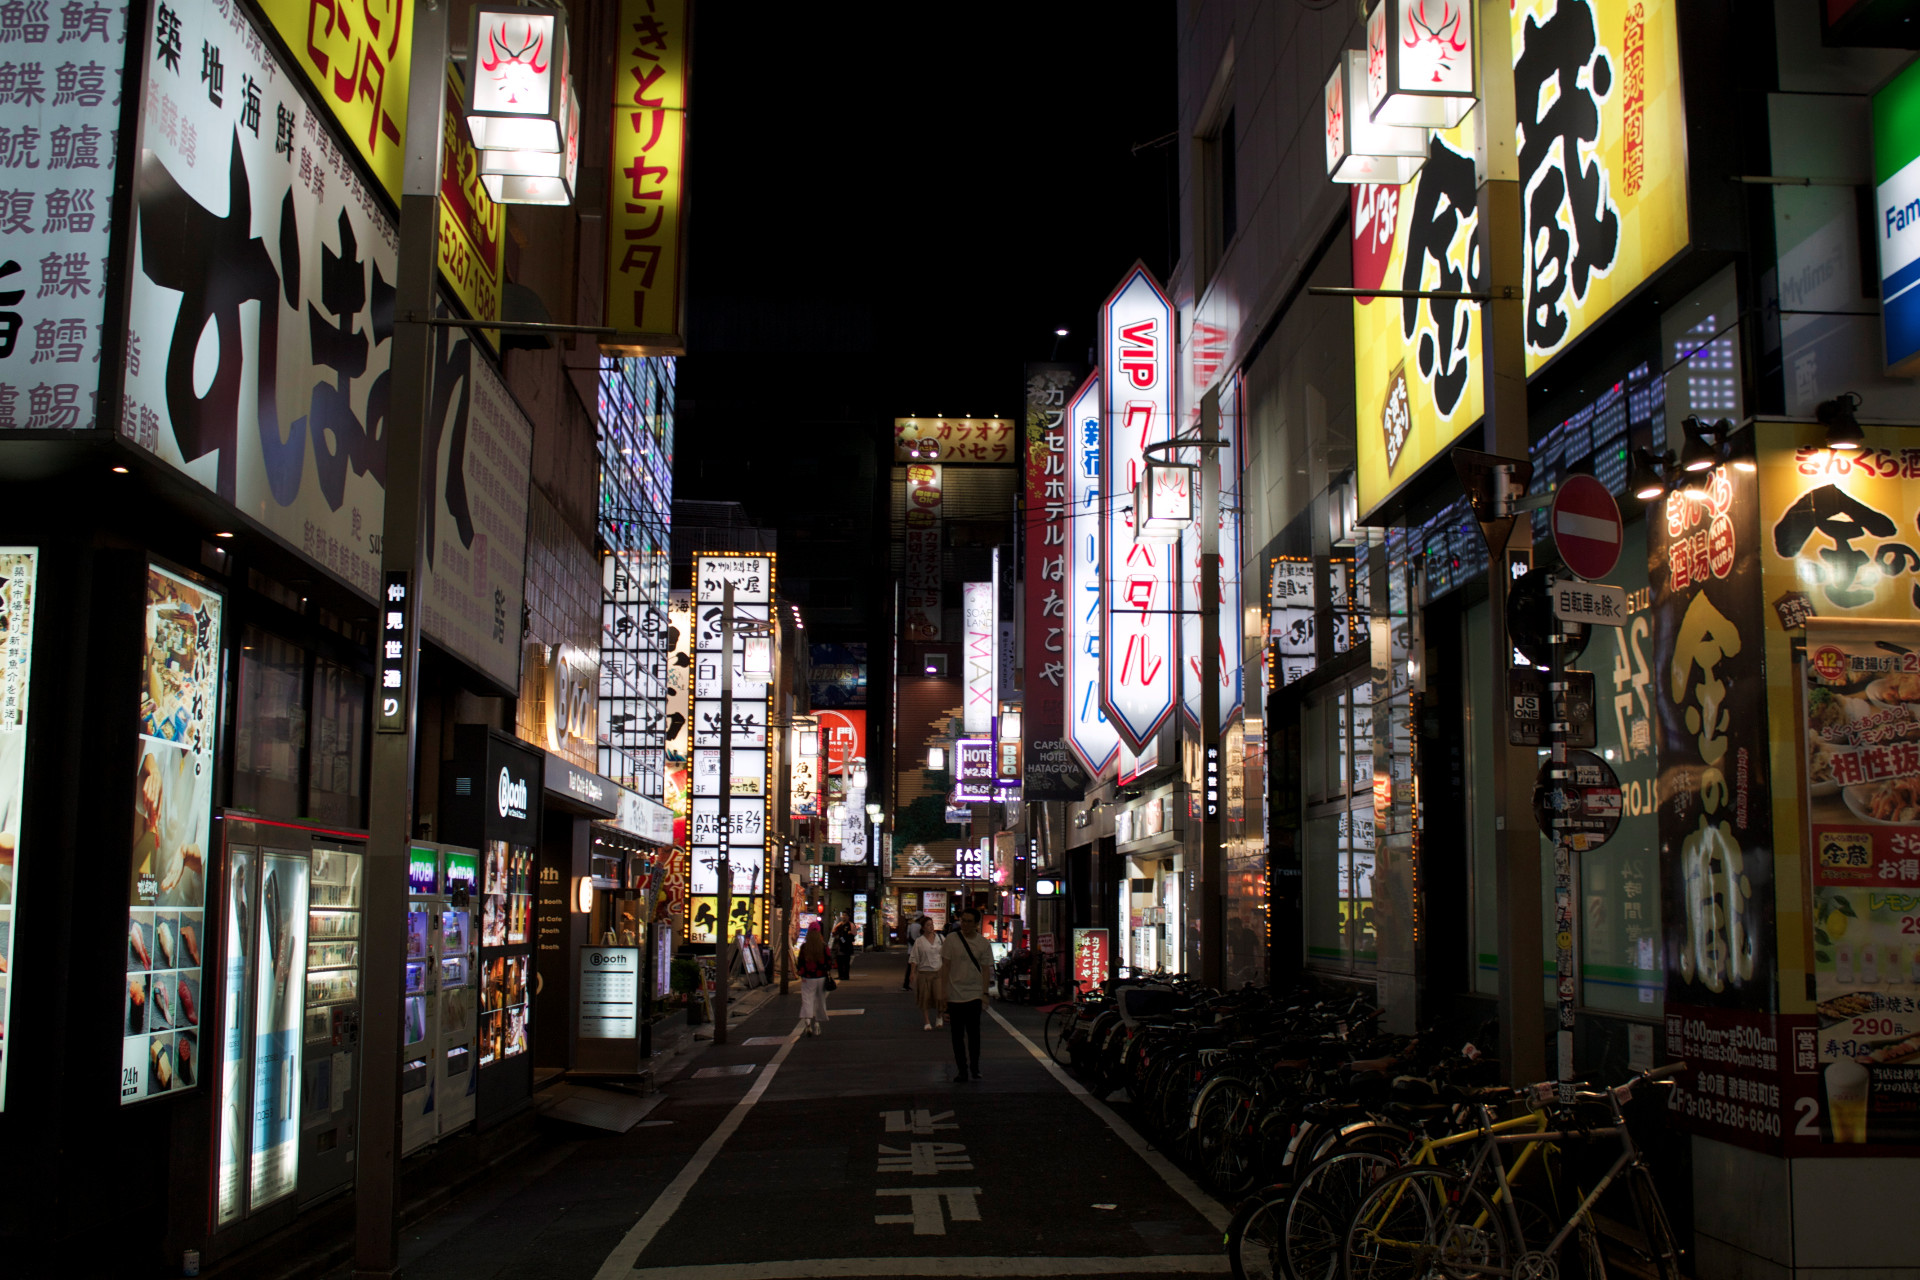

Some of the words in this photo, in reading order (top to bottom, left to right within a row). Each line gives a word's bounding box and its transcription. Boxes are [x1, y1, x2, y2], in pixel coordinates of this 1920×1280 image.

[156, 4, 297, 164] 築地海鮮
[1622, 1, 1645, 198] 登録商標
[619, 0, 669, 329] きとりセンター
[1119, 318, 1159, 391] VIP
[936, 421, 1014, 441] カラオケ
[945, 443, 1008, 461] パセラ
[1711, 519, 1727, 540] KIN
[1715, 537, 1727, 551] no
[1669, 529, 1709, 592] 酒場
[1711, 548, 1734, 570] KURA
[700, 592, 711, 600] 7F
[1560, 590, 1622, 619] 自転車を除く
[966, 619, 992, 629] LAND
[383, 583, 406, 717] 仲見世通り
[699, 641, 709, 649] 6F
[968, 631, 993, 706] MAX
[1851, 656, 1892, 672] 唐揚げ
[698, 689, 708, 697] 5F
[1517, 698, 1537, 709] JS
[1515, 709, 1539, 719] ONE
[1002, 745, 1018, 776] BBQ
[1040, 752, 1069, 762] HOTEL
[1028, 764, 1080, 774] HATAGOYA
[498, 766, 528, 818] Booth
[695, 824, 744, 834] PAROR
[696, 814, 744, 824] ATHEE
[1823, 842, 1868, 867] 金の蔵
[1877, 858, 1920, 881] お得
[694, 884, 704, 892] 1F
[590, 952, 628, 967] Booth
[1081, 936, 1091, 978] はたごや
[1091, 936, 1101, 989] カプセルホテル
[123, 1067, 138, 1088] 24h
[1697, 1070, 1726, 1098] 金の蔵
[1697, 1097, 1781, 1138] 03-5286-6640
